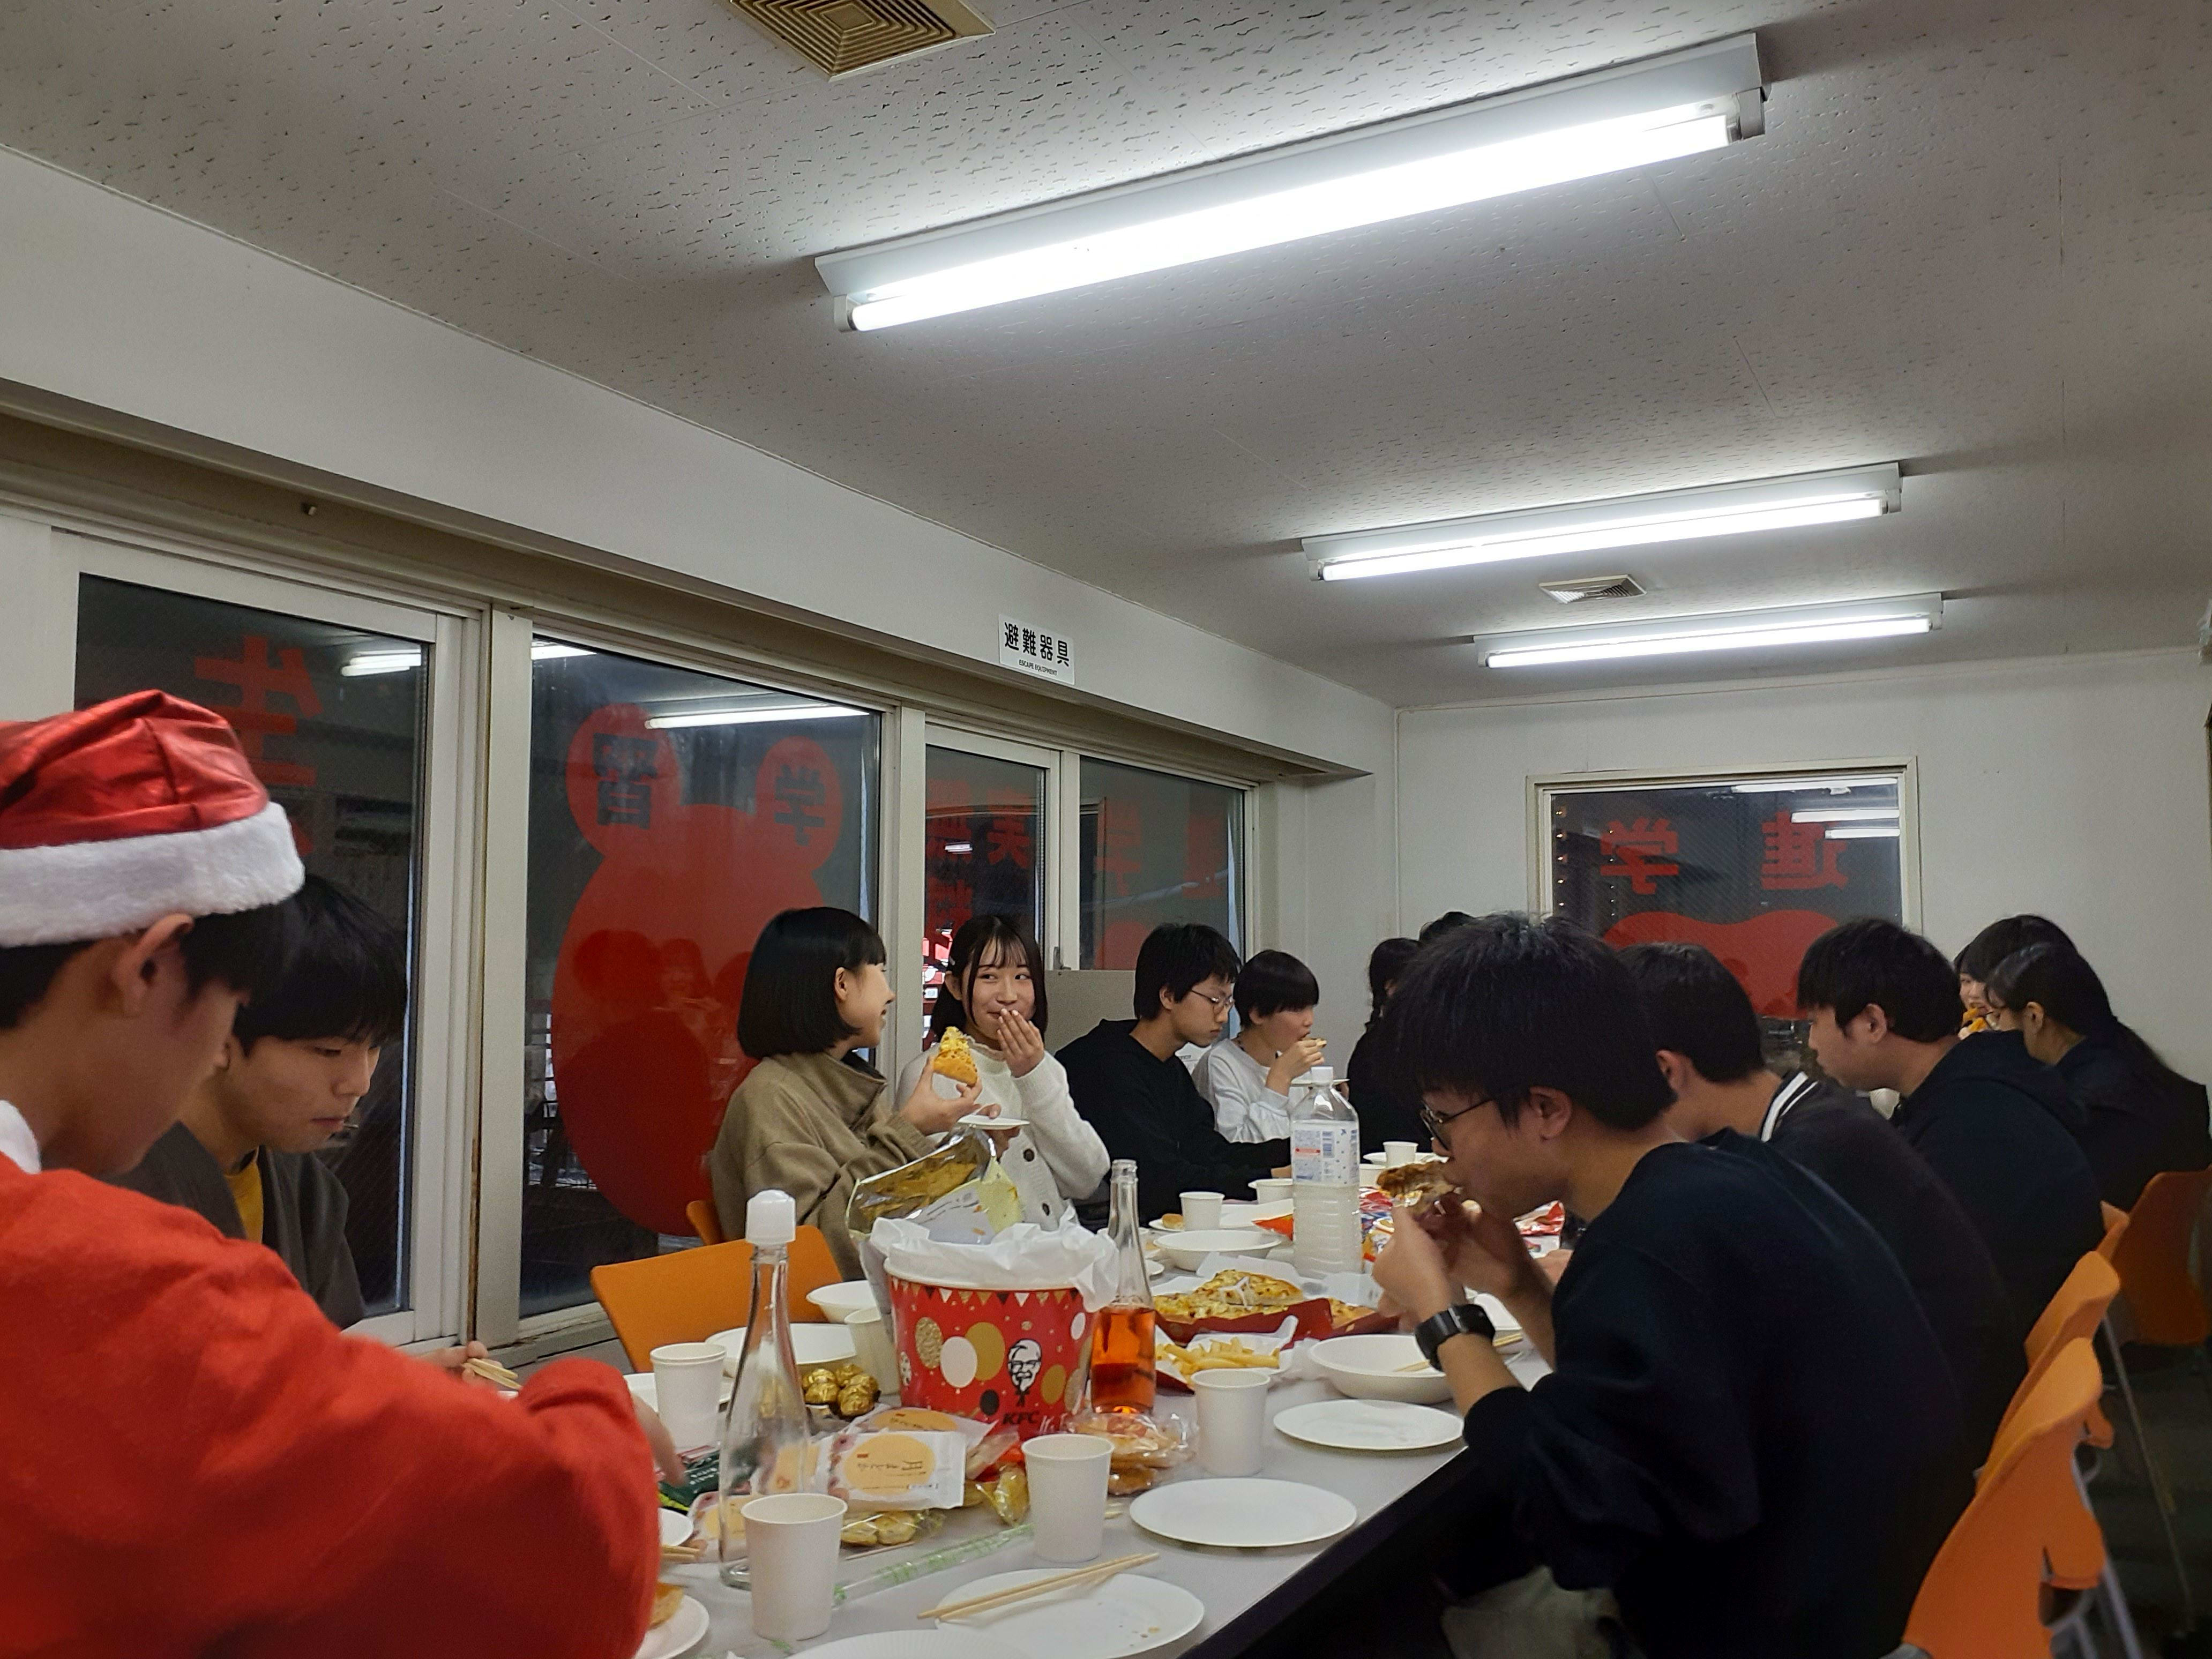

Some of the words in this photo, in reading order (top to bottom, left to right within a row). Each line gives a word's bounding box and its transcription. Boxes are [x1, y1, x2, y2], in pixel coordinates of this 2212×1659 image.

[1004, 622, 1070, 667] 避難器具
[1019, 659, 1034, 668] ESCAPE
[1034, 664, 1057, 676] EQUIPMENT
[1003, 1410, 1040, 1424] KFC
